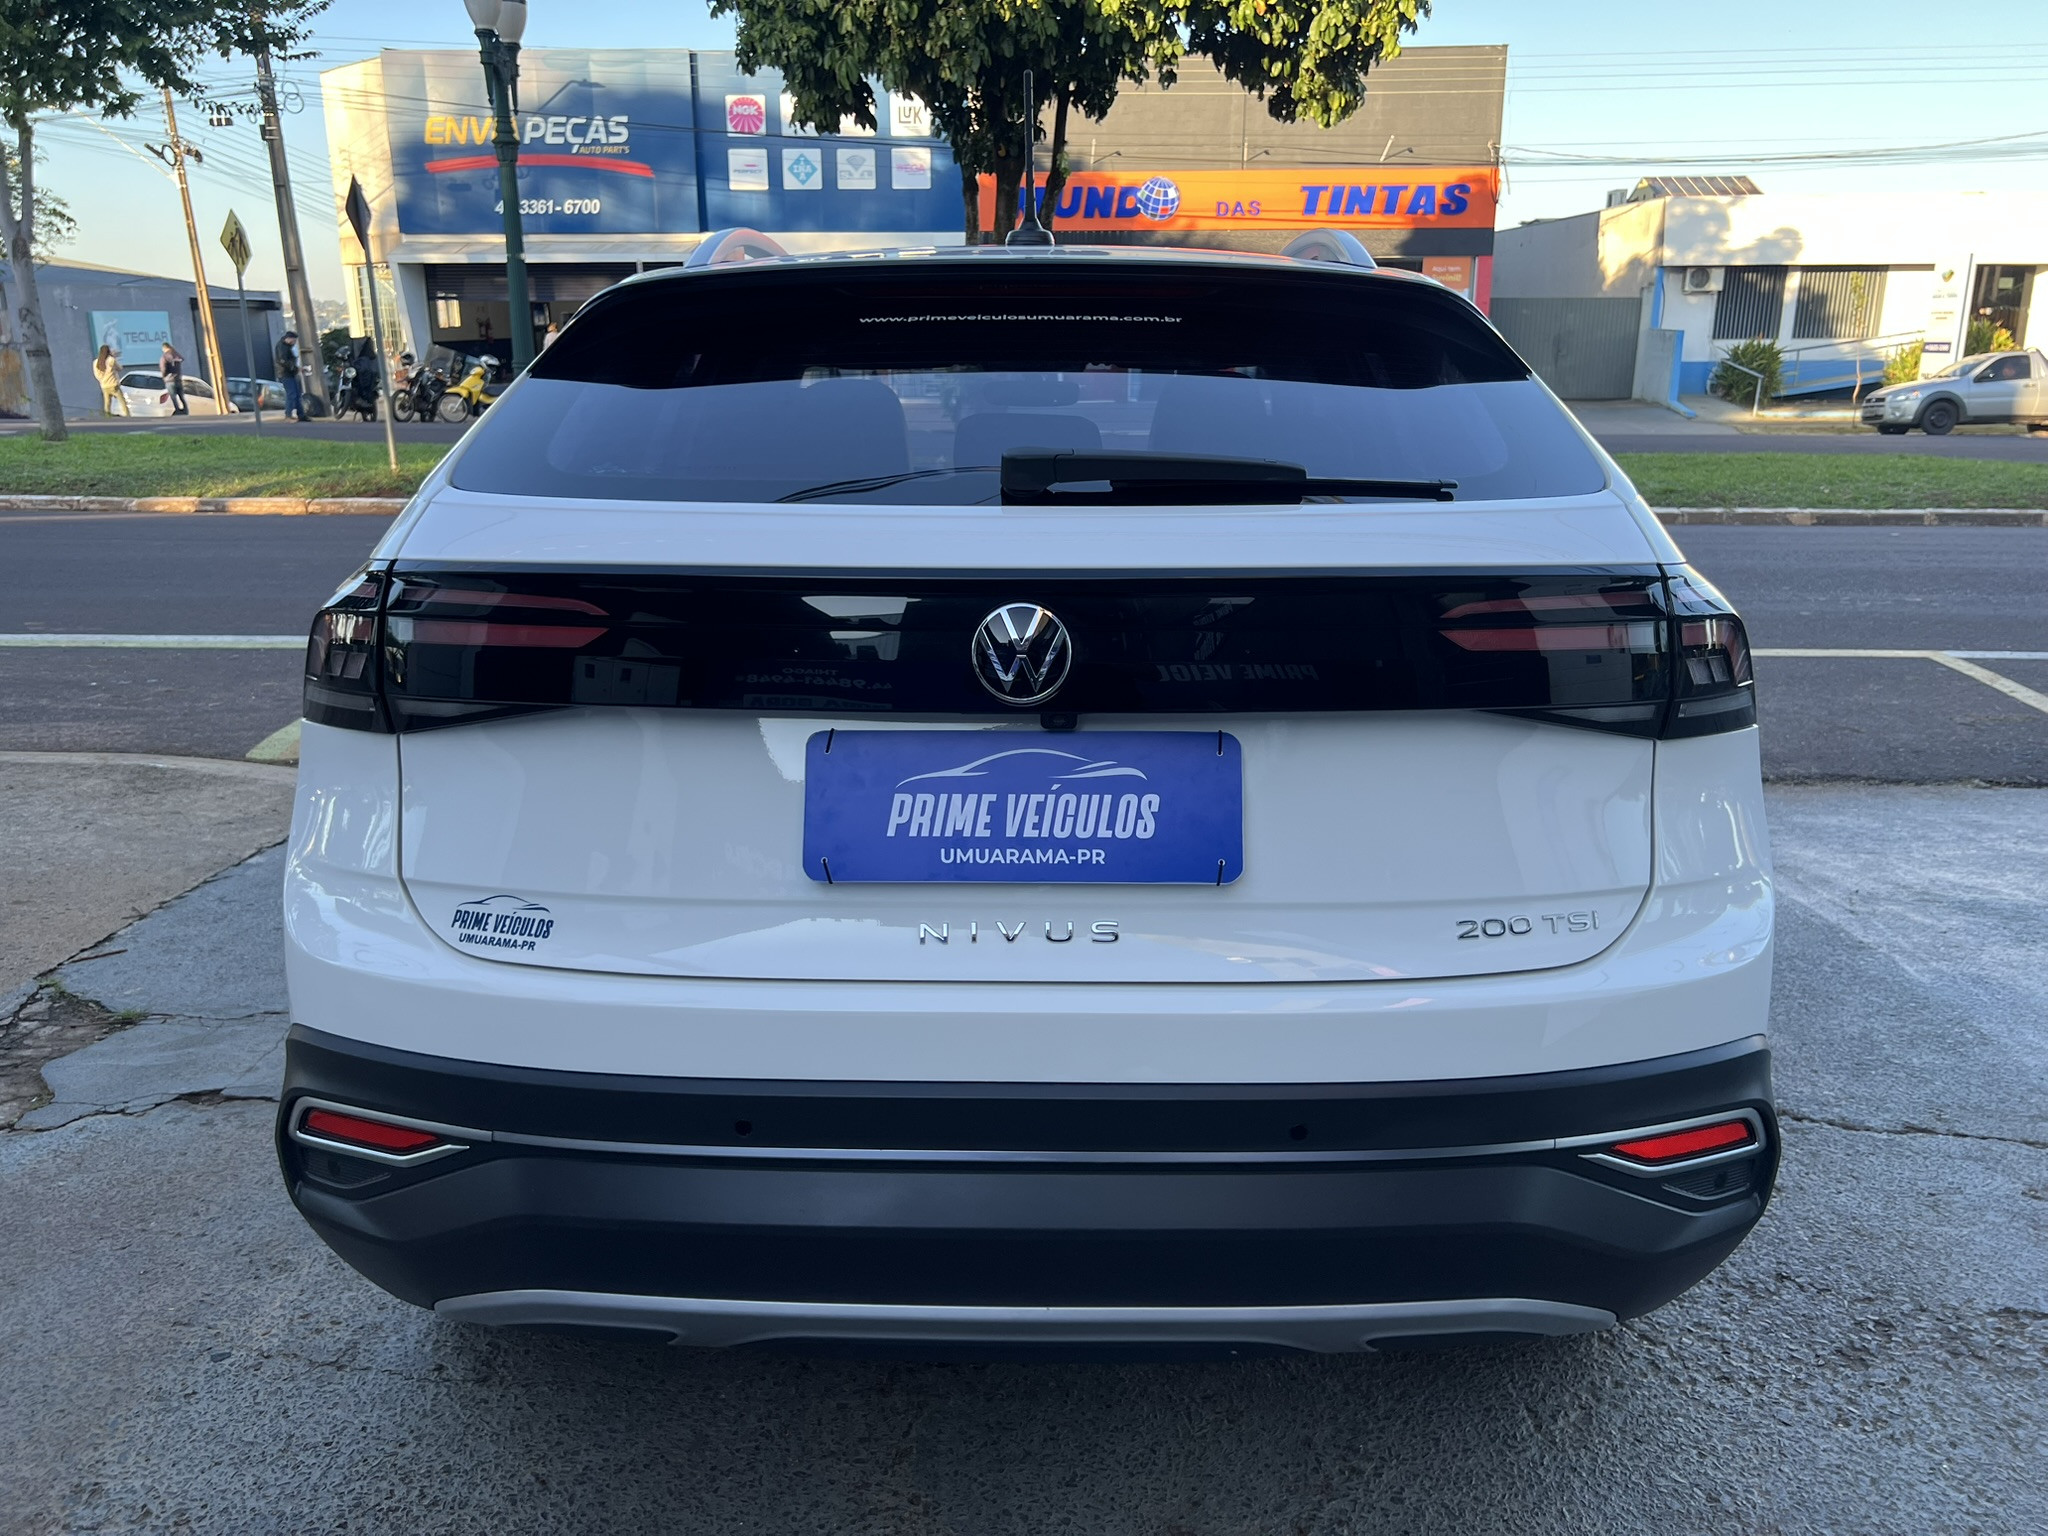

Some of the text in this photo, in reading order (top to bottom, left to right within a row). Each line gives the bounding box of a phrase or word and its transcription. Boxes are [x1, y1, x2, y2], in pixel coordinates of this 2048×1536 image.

[733, 105, 759, 115] NGK
[523, 115, 629, 154] PEÇAS
[579, 145, 602, 154] AUTO
[519, 199, 601, 215] 3361-6700
[1216, 201, 1261, 217] DAS
[1301, 183, 1471, 216] TINTAS
[859, 313, 1182, 323] www.primeveiculosumuarama.com.br
[123, 331, 169, 343] TECILAR
[886, 784, 1160, 839] PRIME VEÍCULOS
[940, 848, 1106, 865] UMUARAMA-PR
[451, 909, 554, 939] PRIME VEÍCULOS
[919, 920, 1120, 944] NIVUS
[1456, 910, 1600, 940] 200 TSI
[458, 933, 536, 951] UMUARAMA-PR
